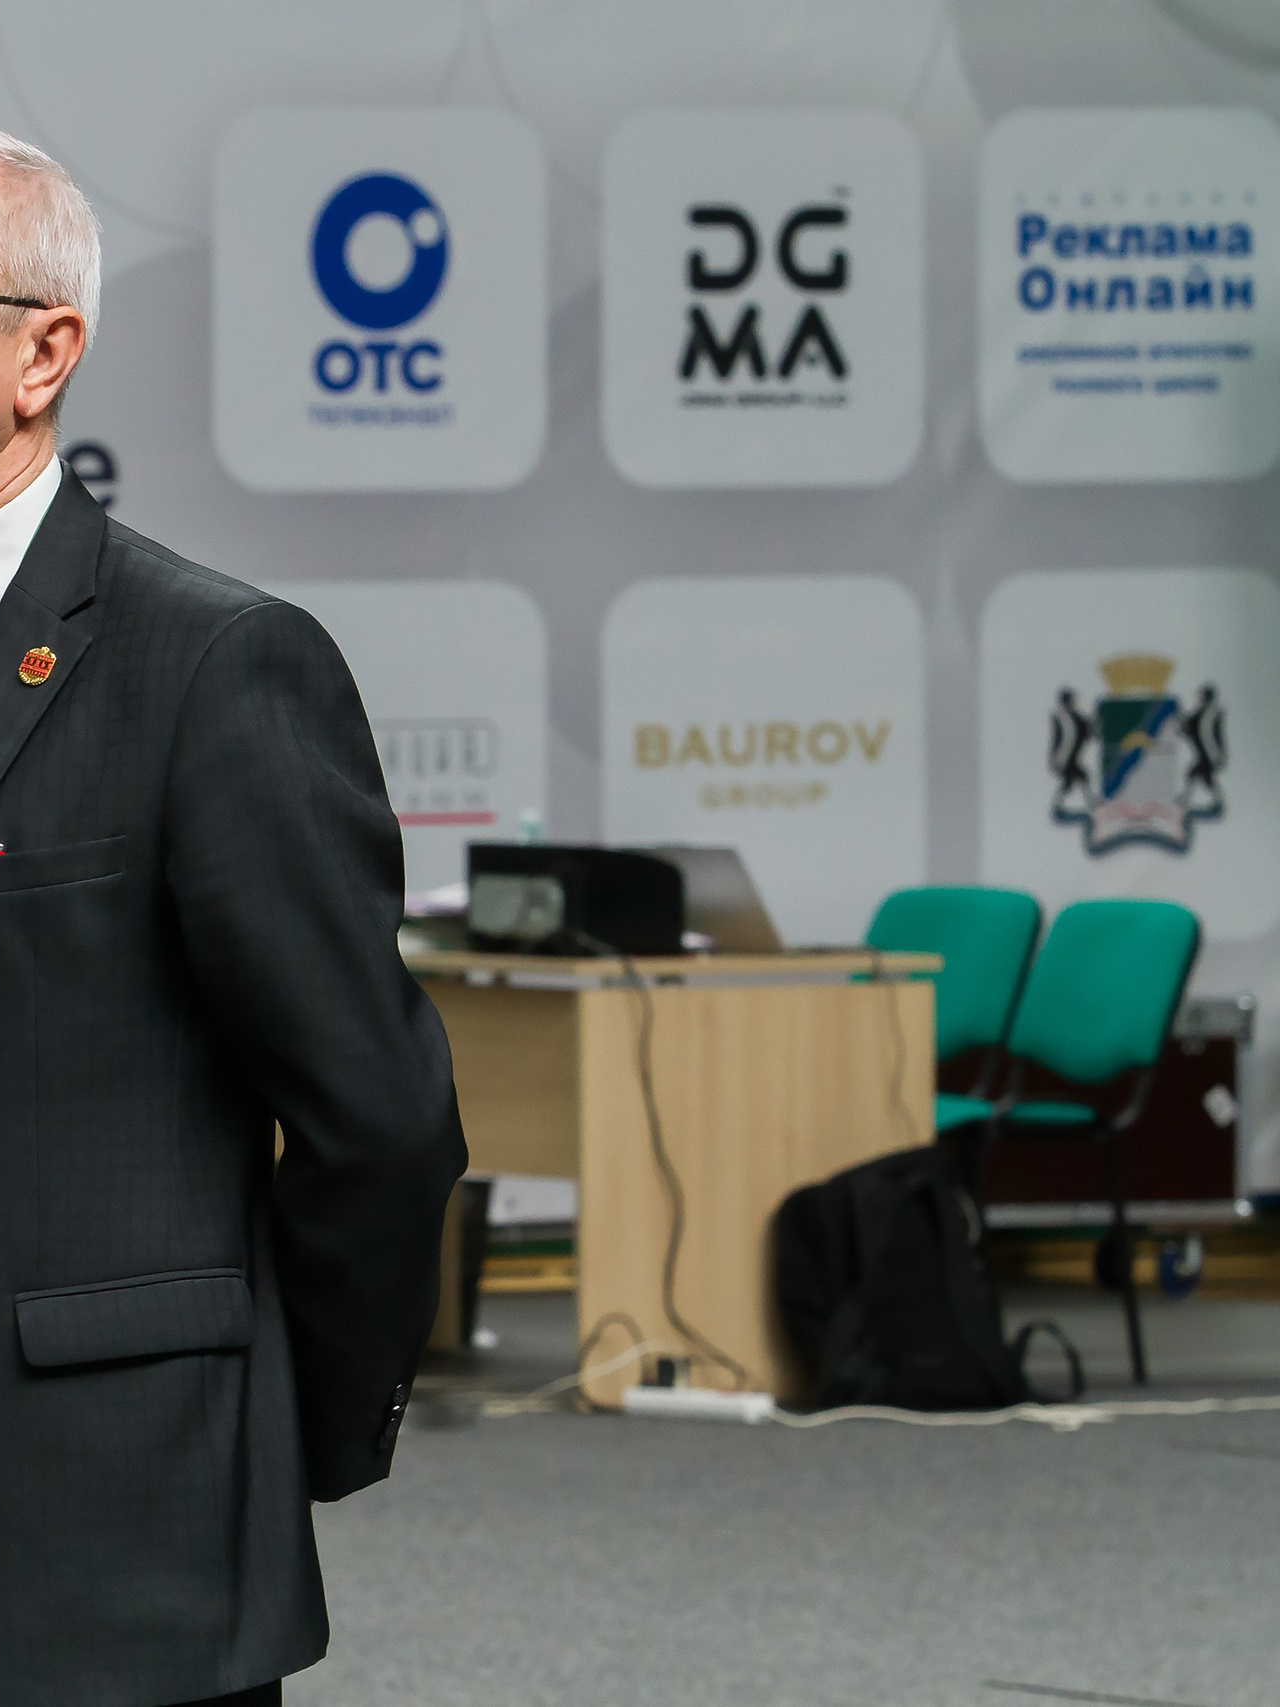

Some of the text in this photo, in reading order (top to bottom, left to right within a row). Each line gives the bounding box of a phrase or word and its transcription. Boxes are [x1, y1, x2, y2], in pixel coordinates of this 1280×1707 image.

[1016, 213, 1253, 258] Реклама
[1017, 264, 1254, 313] Онлайн
[314, 340, 443, 394] ОТС
[633, 720, 893, 769] BAUROV
